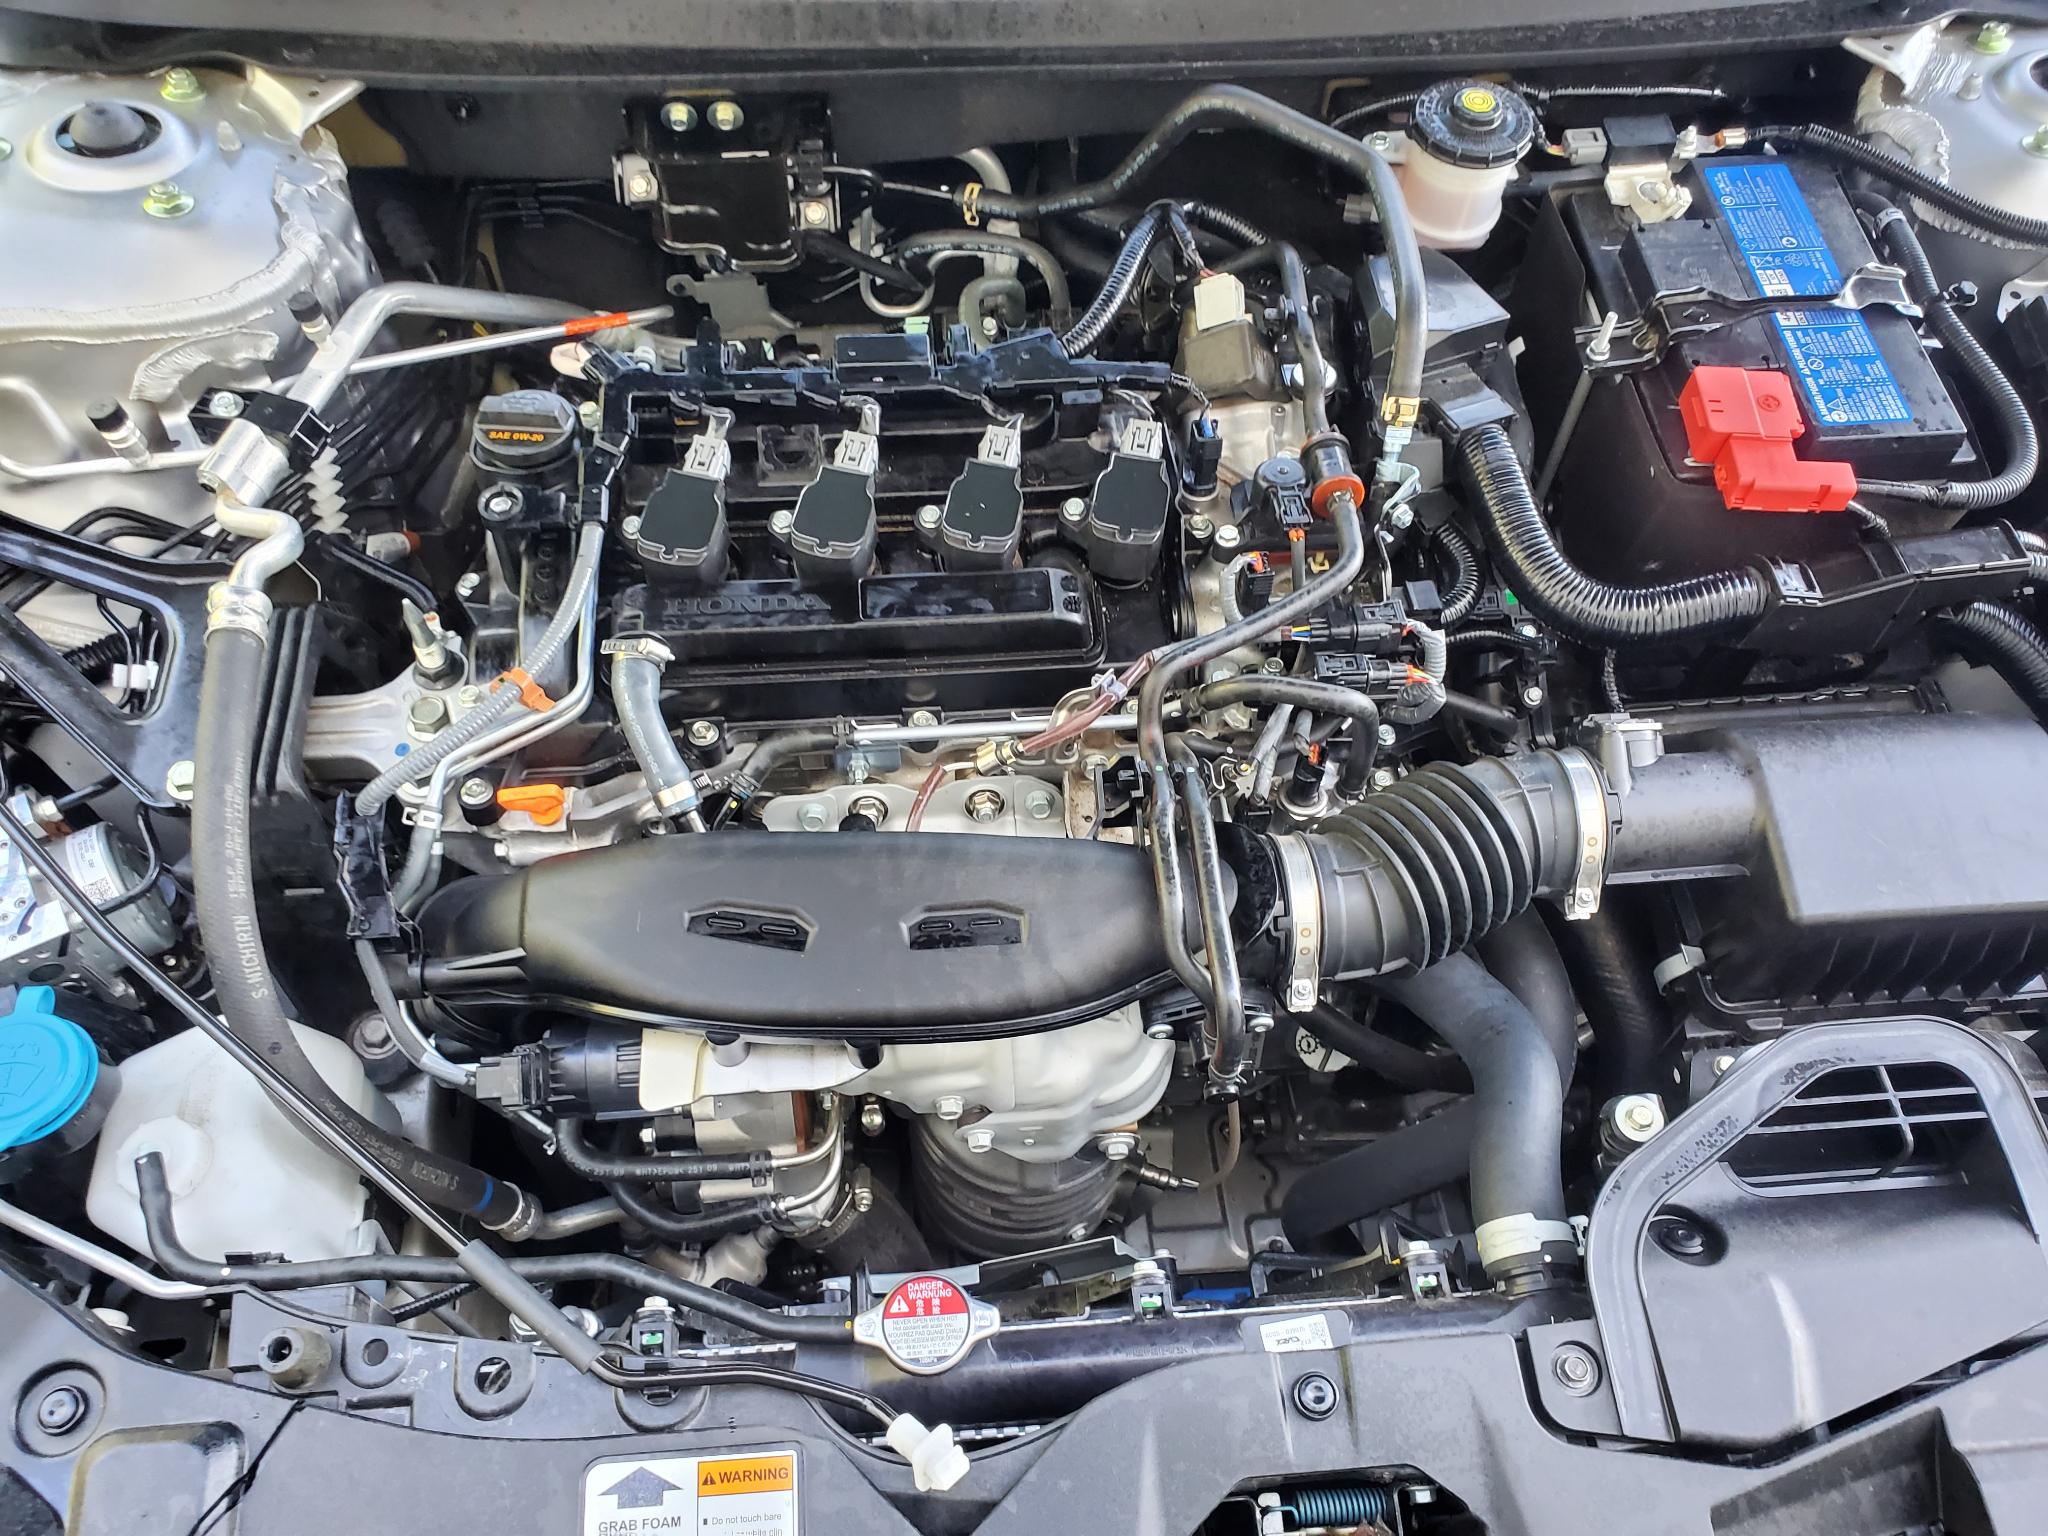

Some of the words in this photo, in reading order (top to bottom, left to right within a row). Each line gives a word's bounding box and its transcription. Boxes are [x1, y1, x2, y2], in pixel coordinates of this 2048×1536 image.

[488, 430, 511, 440] SAE
[512, 432, 545, 442] 0W-20
[662, 592, 832, 617] HONDA
[908, 1281, 943, 1291] DANGER
[908, 1288, 952, 1300] WARNUNG
[719, 1467, 789, 1484] WARNING
[598, 1519, 638, 1533] GRAB
[642, 1516, 682, 1530] FOAM
[711, 1517, 723, 1526] Do
[725, 1515, 738, 1524] not
[740, 1513, 761, 1524] touch
[764, 1512, 782, 1521] bare
